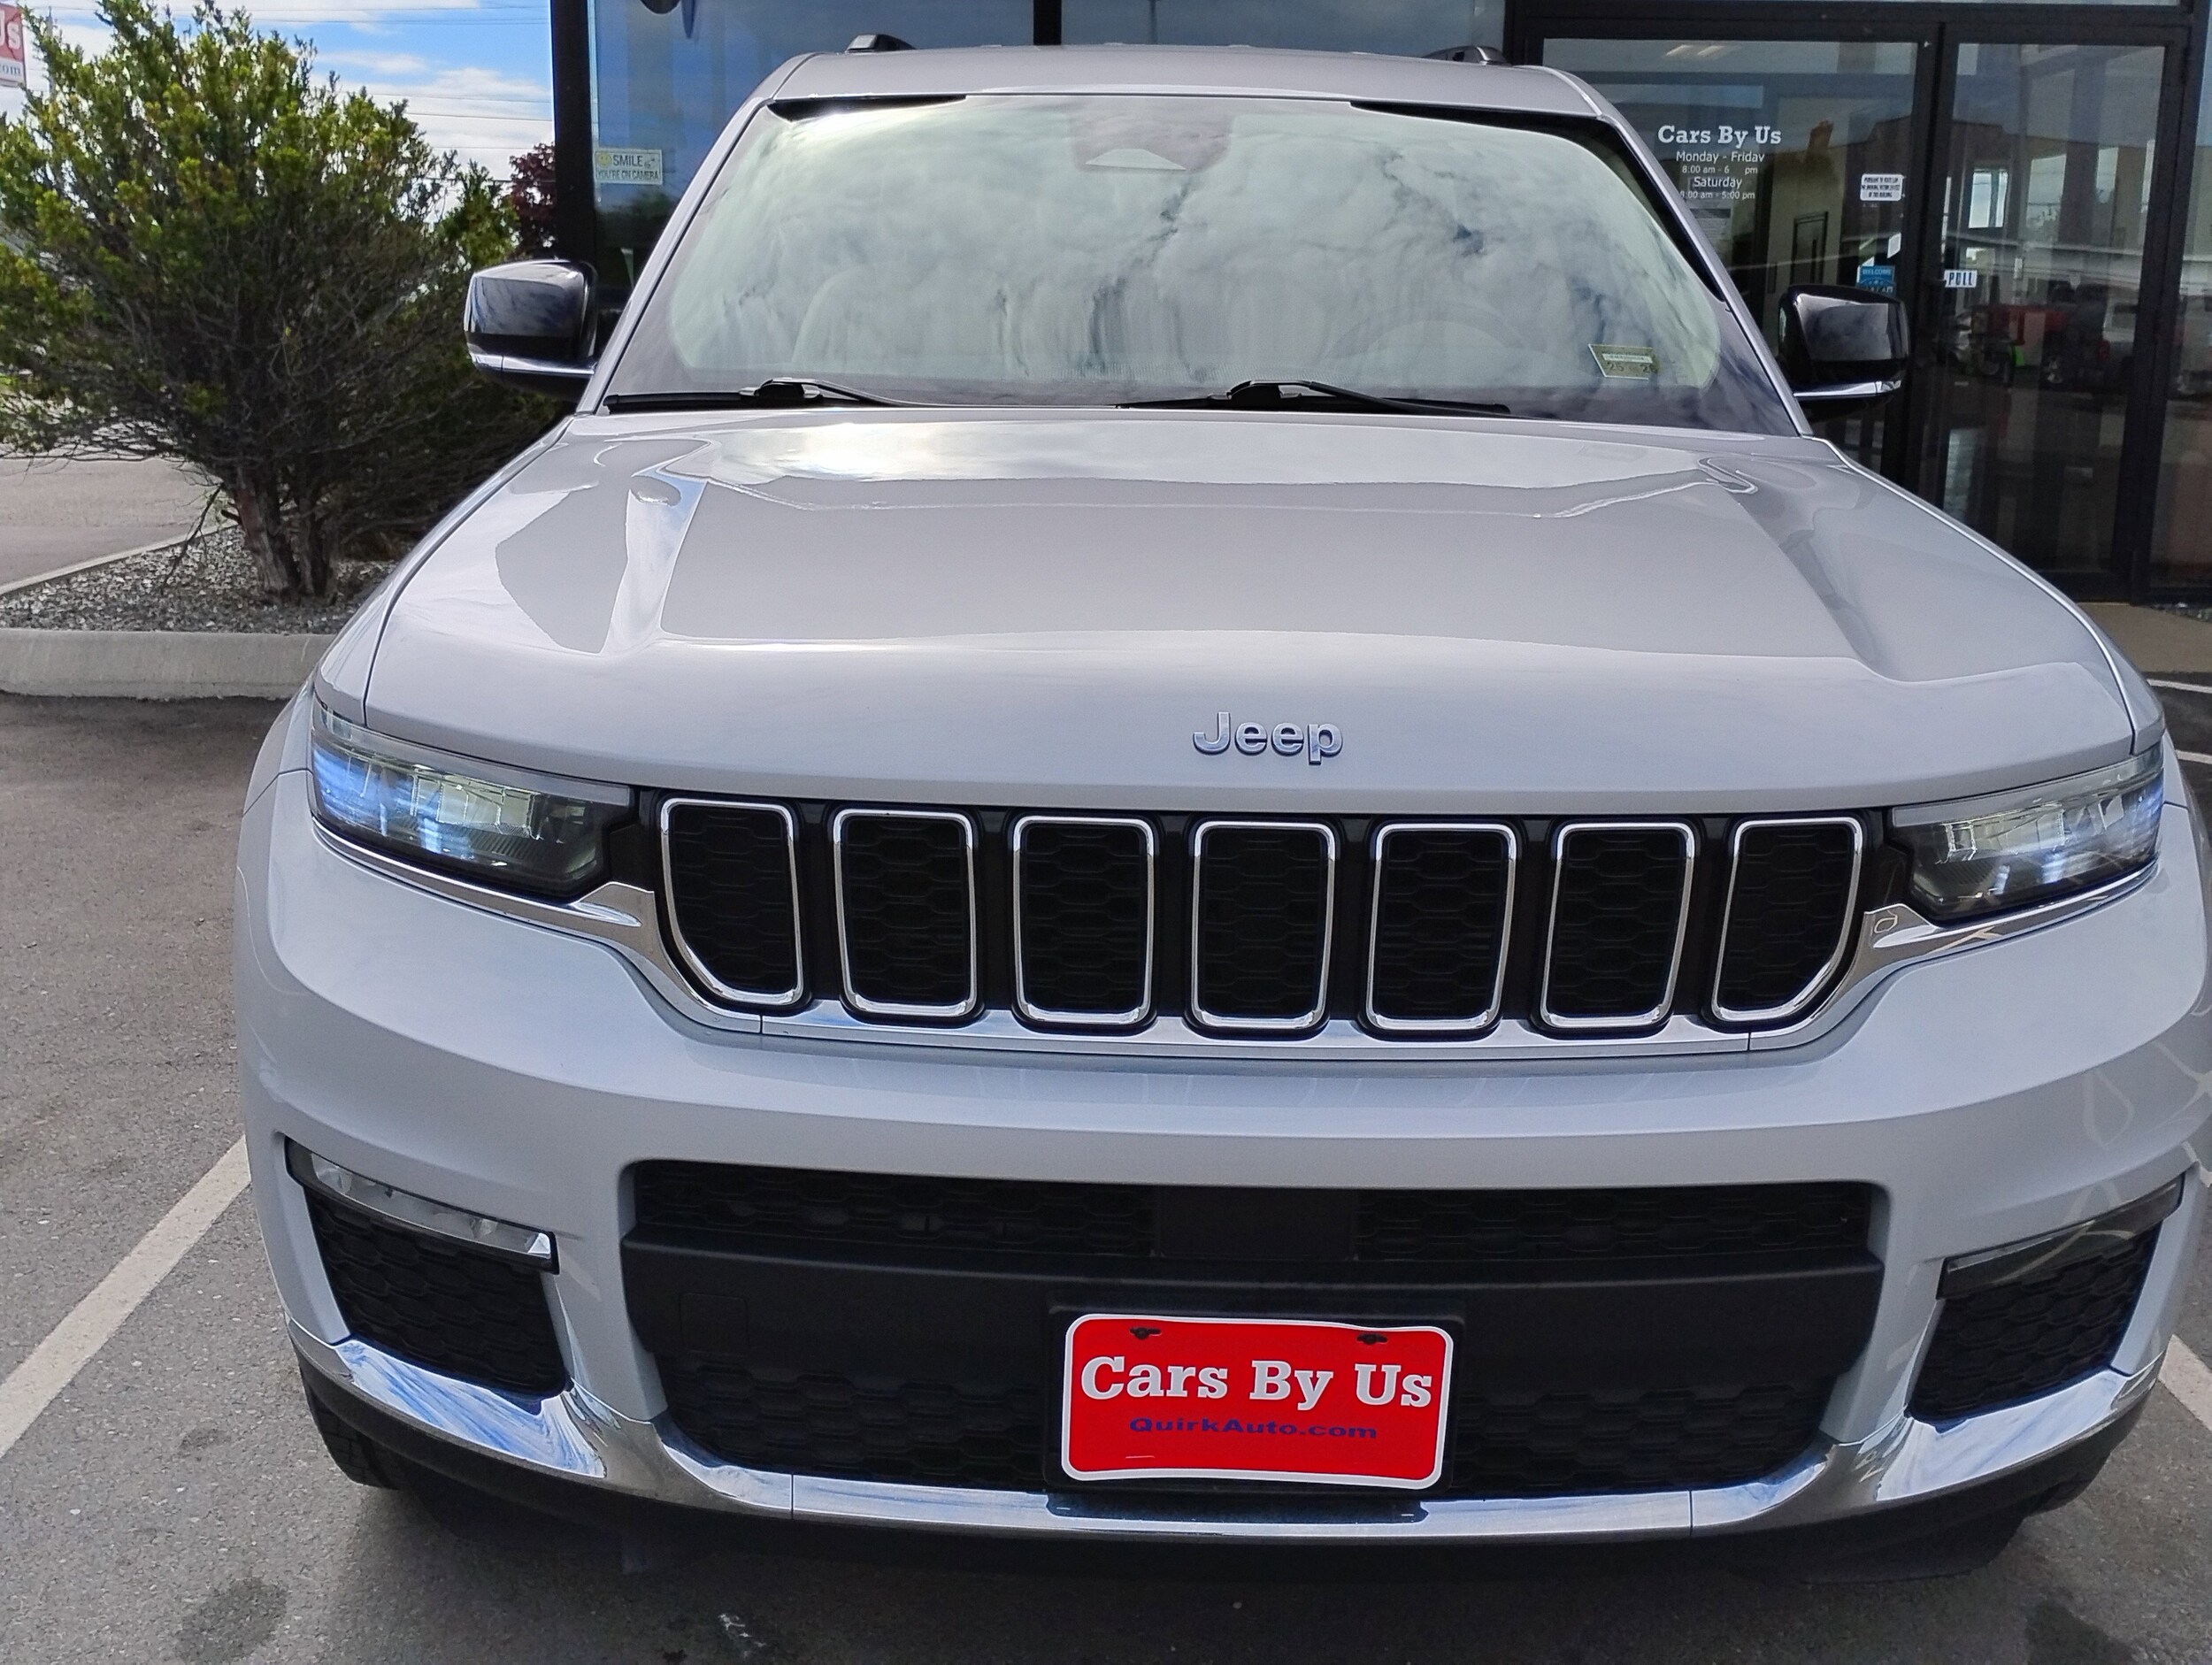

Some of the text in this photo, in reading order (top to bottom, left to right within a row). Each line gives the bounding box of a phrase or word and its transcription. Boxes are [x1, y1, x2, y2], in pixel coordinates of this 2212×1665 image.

[1657, 125, 1782, 149] Cars By Us
[612, 154, 643, 167] SMILE
[1676, 150, 1719, 165] Monday
[632, 170, 659, 180] CAMERA
[1682, 165, 1701, 174] 8:00
[1694, 176, 1742, 189] Saturday
[1948, 272, 1972, 286] PULL
[1194, 711, 1343, 765] Jeep
[1080, 1355, 1432, 1410] Cars By Us
[1128, 1416, 1377, 1439] QuirkAuto.com
